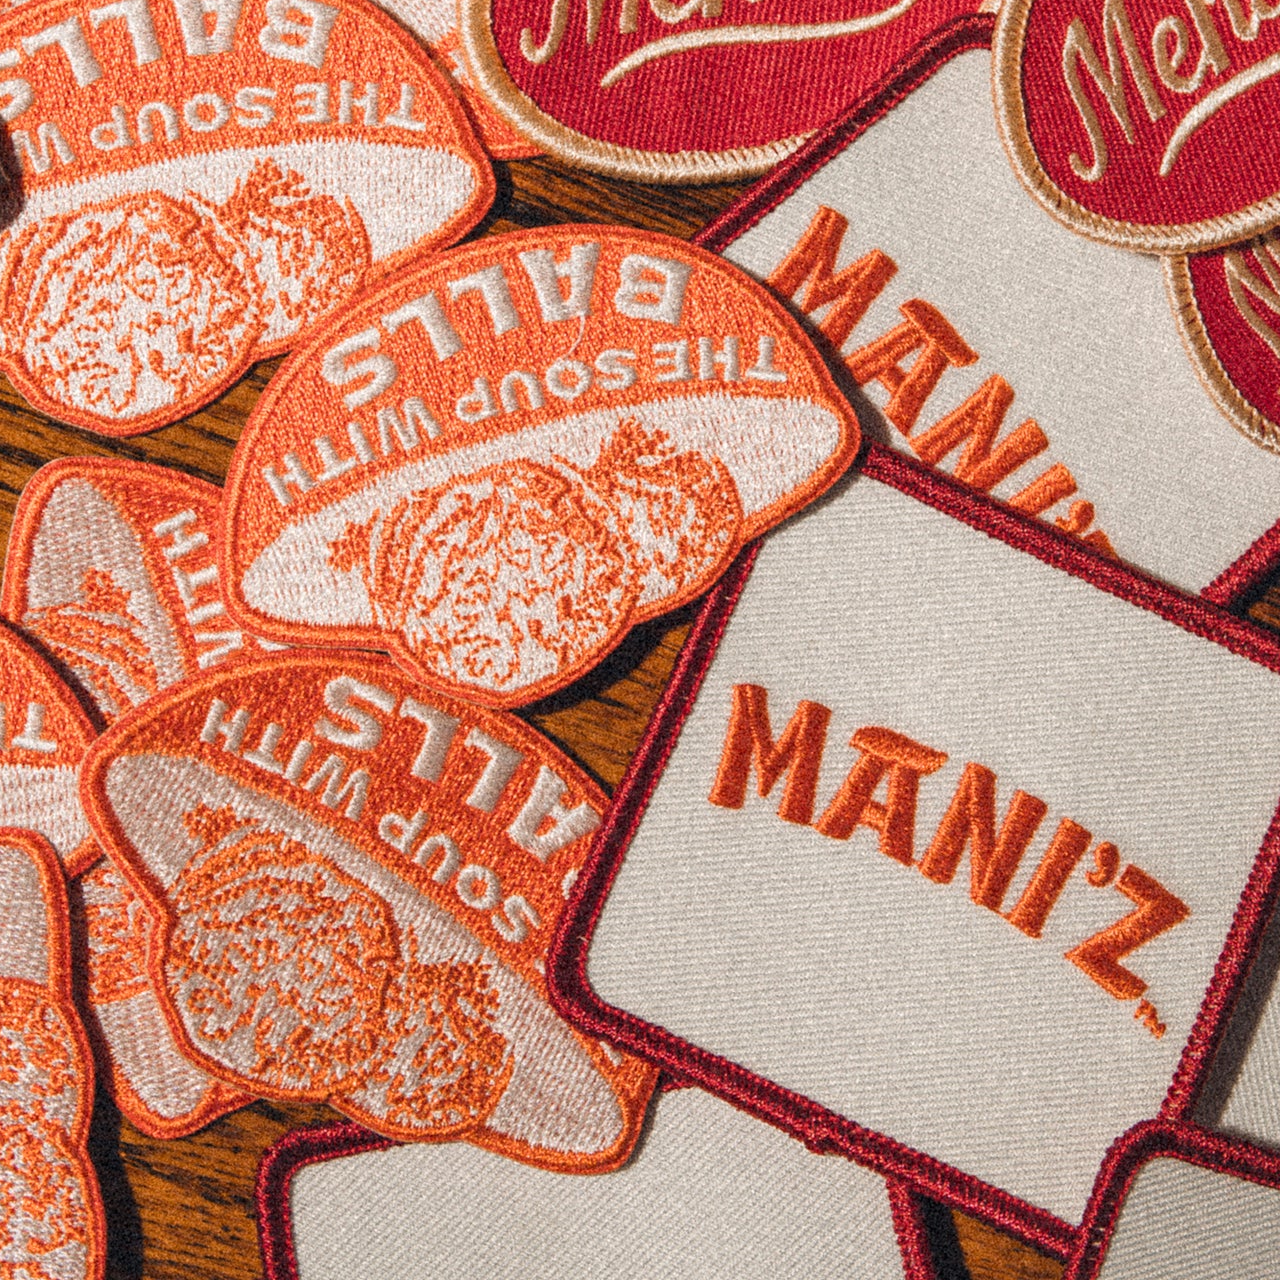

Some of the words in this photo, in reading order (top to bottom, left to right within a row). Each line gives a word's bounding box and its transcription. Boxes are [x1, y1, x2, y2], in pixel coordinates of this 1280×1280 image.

[90, 85, 278, 153] SOUP
[292, 80, 428, 132] THE
[321, 242, 693, 413] BALLS
[652, 335, 789, 384] THE
[455, 348, 639, 425] SOUP
[262, 395, 443, 508] WITH
[200, 698, 372, 821] WITH
[322, 676, 602, 865] ALLS
[378, 811, 542, 945] SOUP
